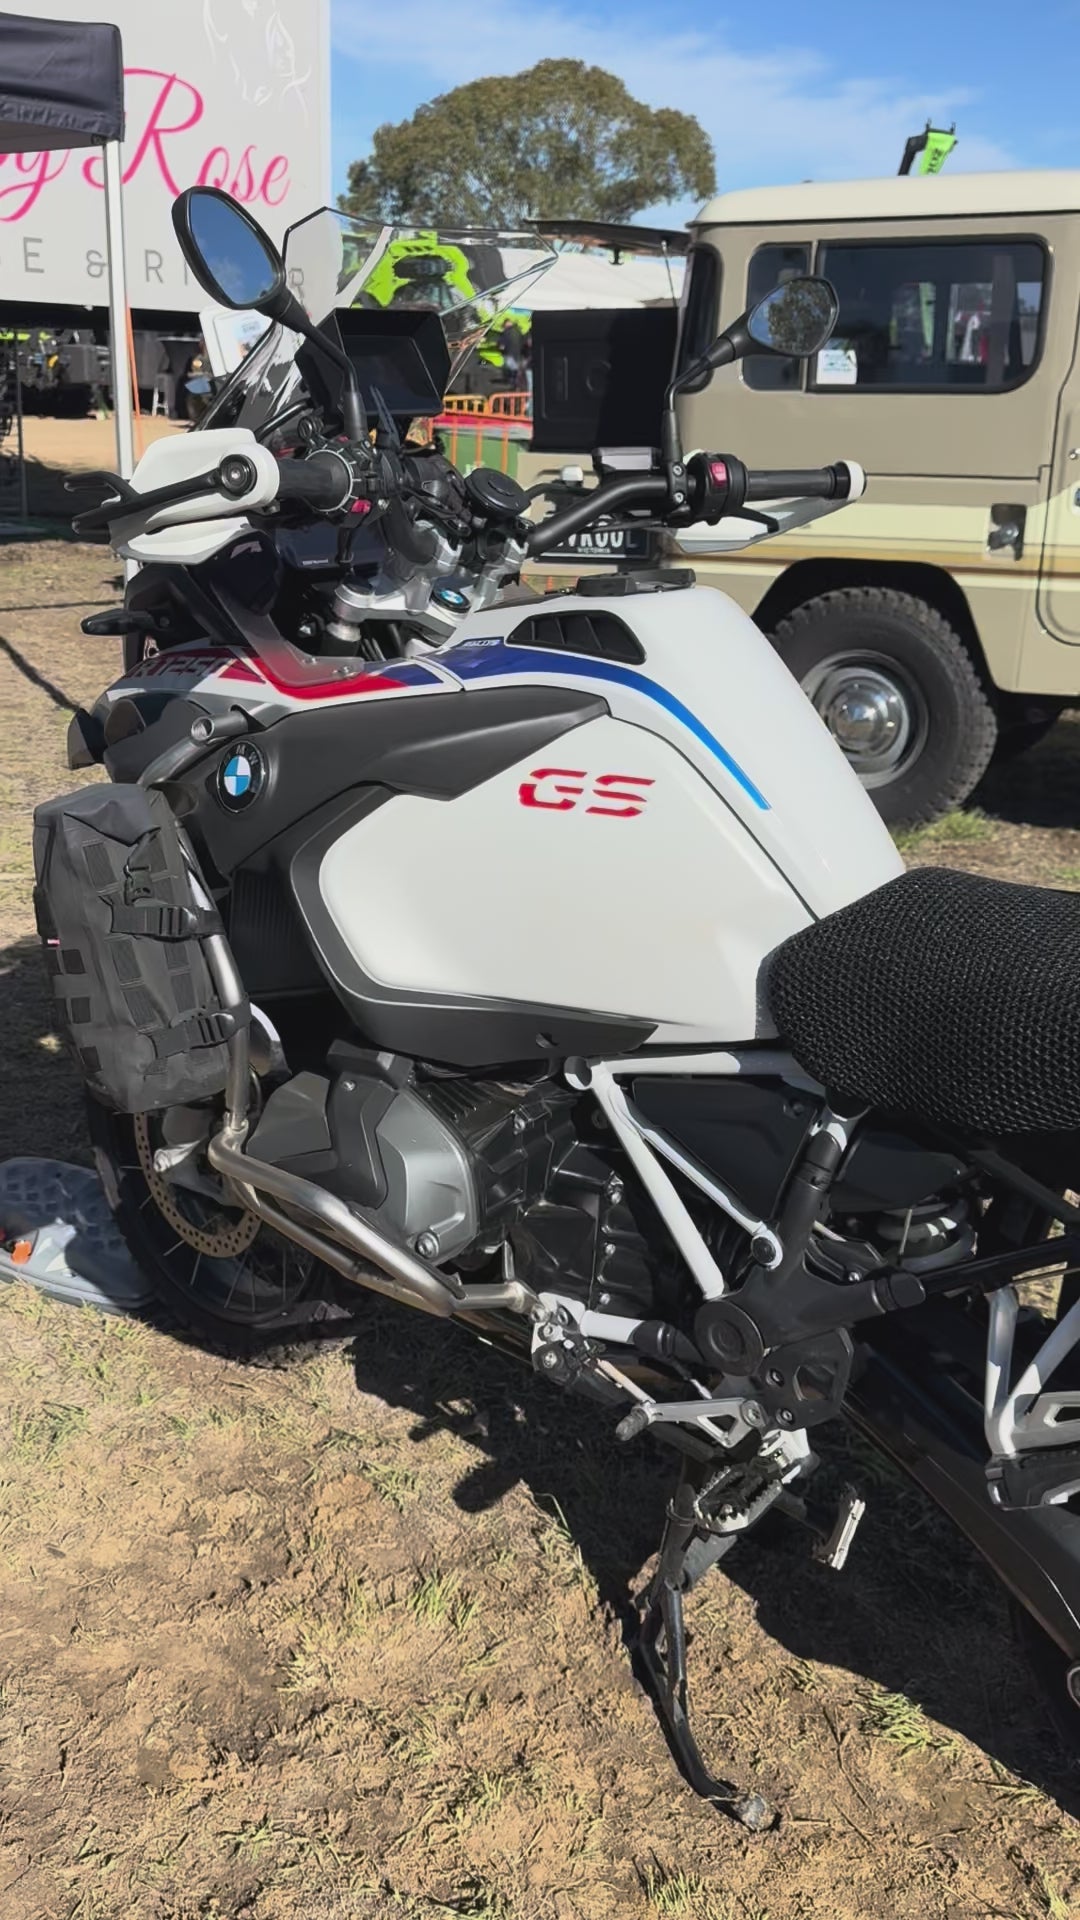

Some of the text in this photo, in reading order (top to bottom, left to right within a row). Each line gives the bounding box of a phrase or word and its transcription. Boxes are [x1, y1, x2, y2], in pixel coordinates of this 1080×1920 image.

[82, 68, 290, 206] Rose
[22, 235, 45, 274] E
[86, 249, 107, 279] &
[518, 767, 657, 818] GS
